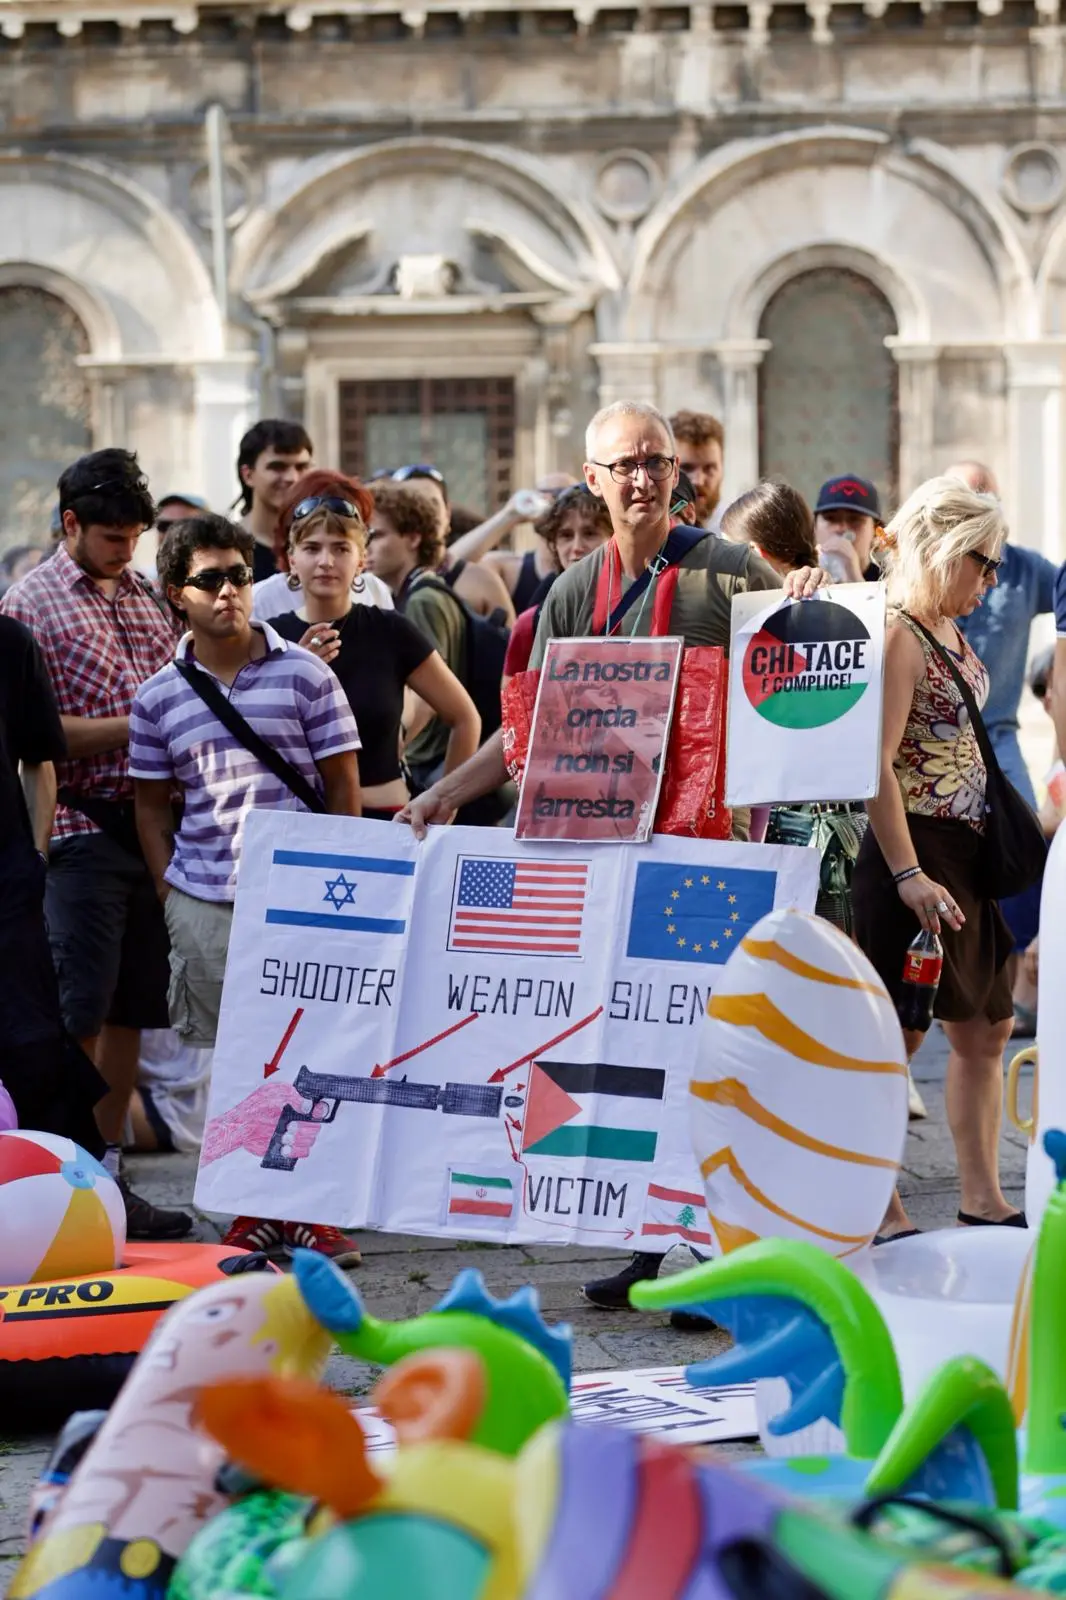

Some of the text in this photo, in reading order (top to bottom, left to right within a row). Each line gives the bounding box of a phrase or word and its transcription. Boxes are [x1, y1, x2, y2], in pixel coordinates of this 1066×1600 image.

[547, 658, 671, 682] La nostra
[750, 640, 867, 676] CHI TACE
[772, 672, 852, 694] COMPLICE!
[566, 704, 639, 729] onda
[554, 750, 635, 774] non si
[259, 957, 396, 1007] SHOOTER
[447, 973, 575, 1018] WEAPON
[527, 1174, 629, 1219] VICTIM
[16, 1280, 115, 1308] PRO
